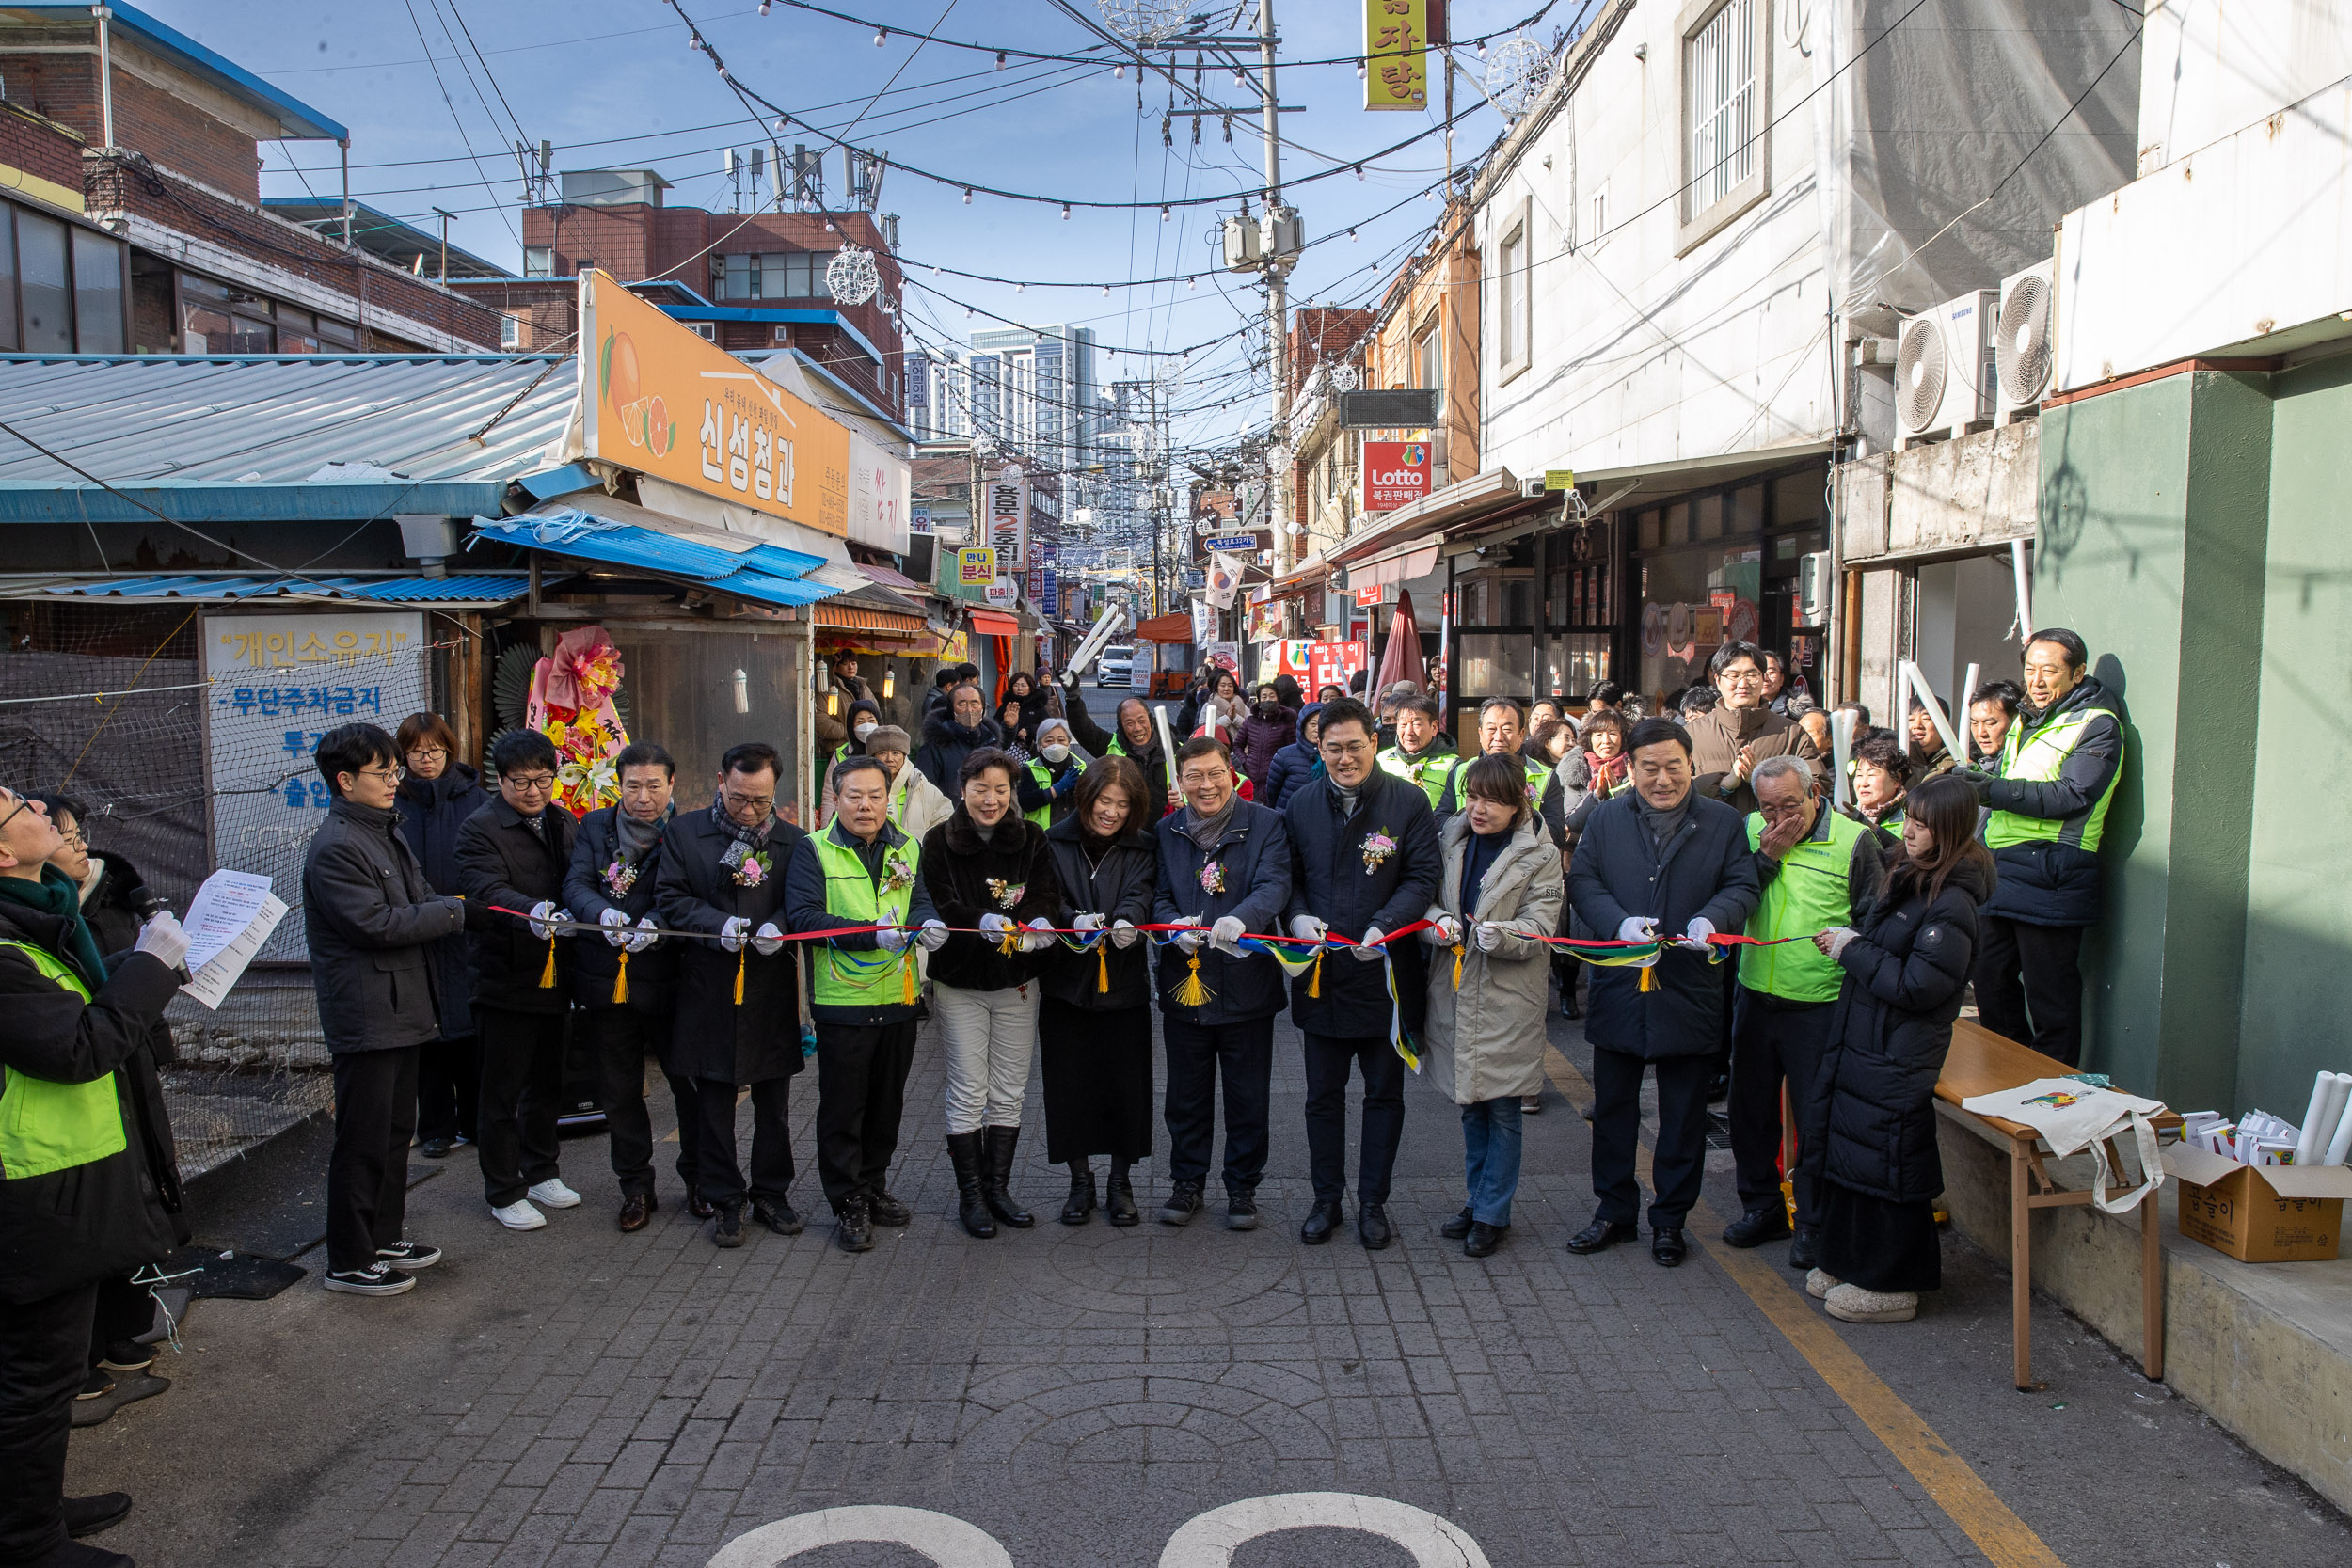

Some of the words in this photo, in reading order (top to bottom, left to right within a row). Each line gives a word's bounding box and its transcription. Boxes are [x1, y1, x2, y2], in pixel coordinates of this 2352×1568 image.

[1951, 307, 1972, 320] SAMSUNG
[913, 367, 923, 403] 어린이집
[700, 398, 795, 509] 신성청과
[1372, 469, 1423, 485] Lotto
[1373, 489, 1423, 501] 복권판매점
[966, 552, 988, 563] 만나
[962, 564, 993, 580] 분식
